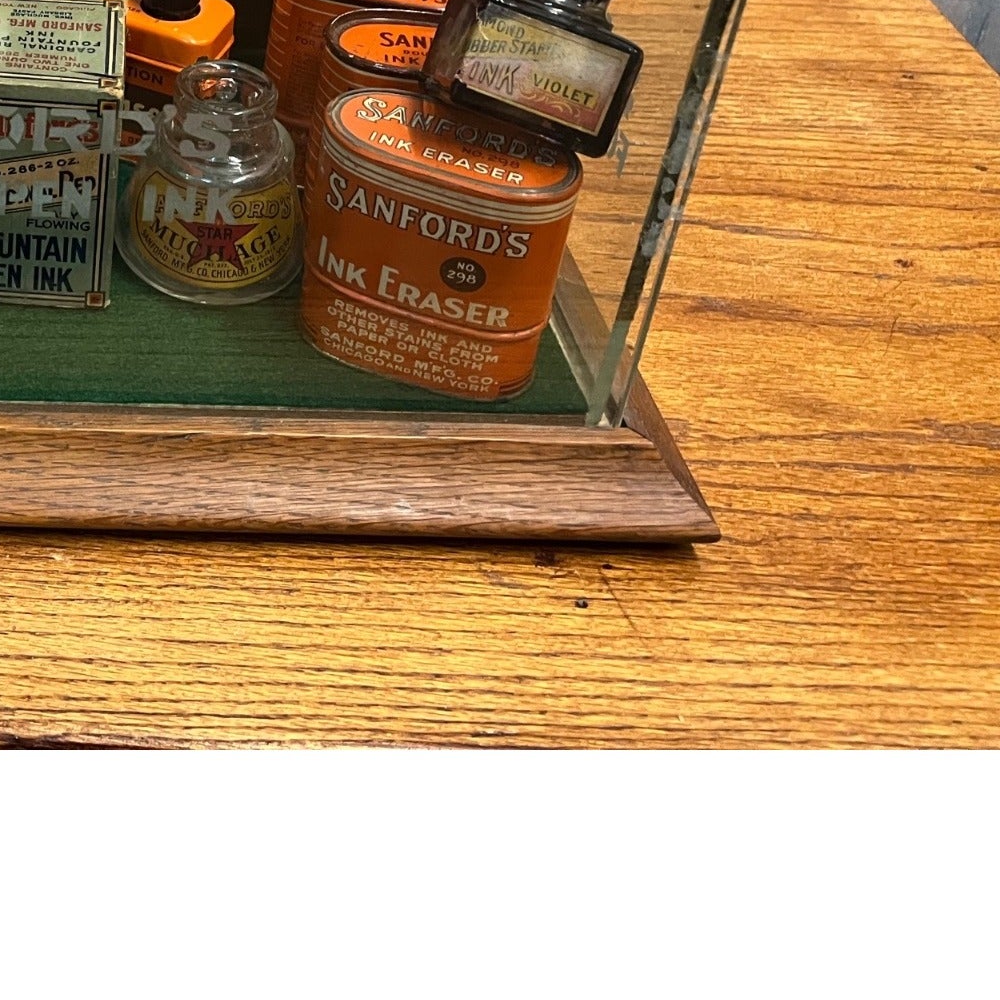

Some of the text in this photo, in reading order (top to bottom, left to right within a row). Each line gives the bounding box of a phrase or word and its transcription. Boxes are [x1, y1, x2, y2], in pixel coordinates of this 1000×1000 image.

[7, 18, 37, 28] MFG.
[42, 20, 103, 32] SANFORD
[18, 36, 101, 47] FOUNTAIN
[19, 42, 96, 54] CARDINAL
[469, 40, 506, 54] BBER
[25, 53, 77, 61] NUMBER
[64, 61, 90, 69] ONE
[384, 54, 420, 65] INK
[5, 62, 68, 73] CONTAINS
[469, 60, 520, 95] INK
[532, 73, 594, 106] VIOLET
[355, 96, 558, 168] SANFORD'S
[57, 157, 80, 167] OZ.
[369, 130, 525, 185] INK ERASER
[142, 184, 243, 223] INK
[326, 170, 532, 260] SANFORD'S
[26, 217, 91, 232] FLOWING
[197, 226, 233, 241] STAR
[259, 254, 275, 270] NEW
[456, 260, 475, 273] NO
[33, 266, 73, 293] INK
[317, 235, 511, 329] INK ERASER
[446, 269, 477, 285] 298
[333, 298, 493, 354] REMOVES INK AND
[327, 306, 500, 364] OTHER STAINS FROM
[337, 319, 484, 372] PAPER OR CLOTH
[320, 325, 405, 364] SANFORD
[467, 375, 499, 386] CO.
[323, 336, 490, 393] CHICAGO AND NEW YORK
